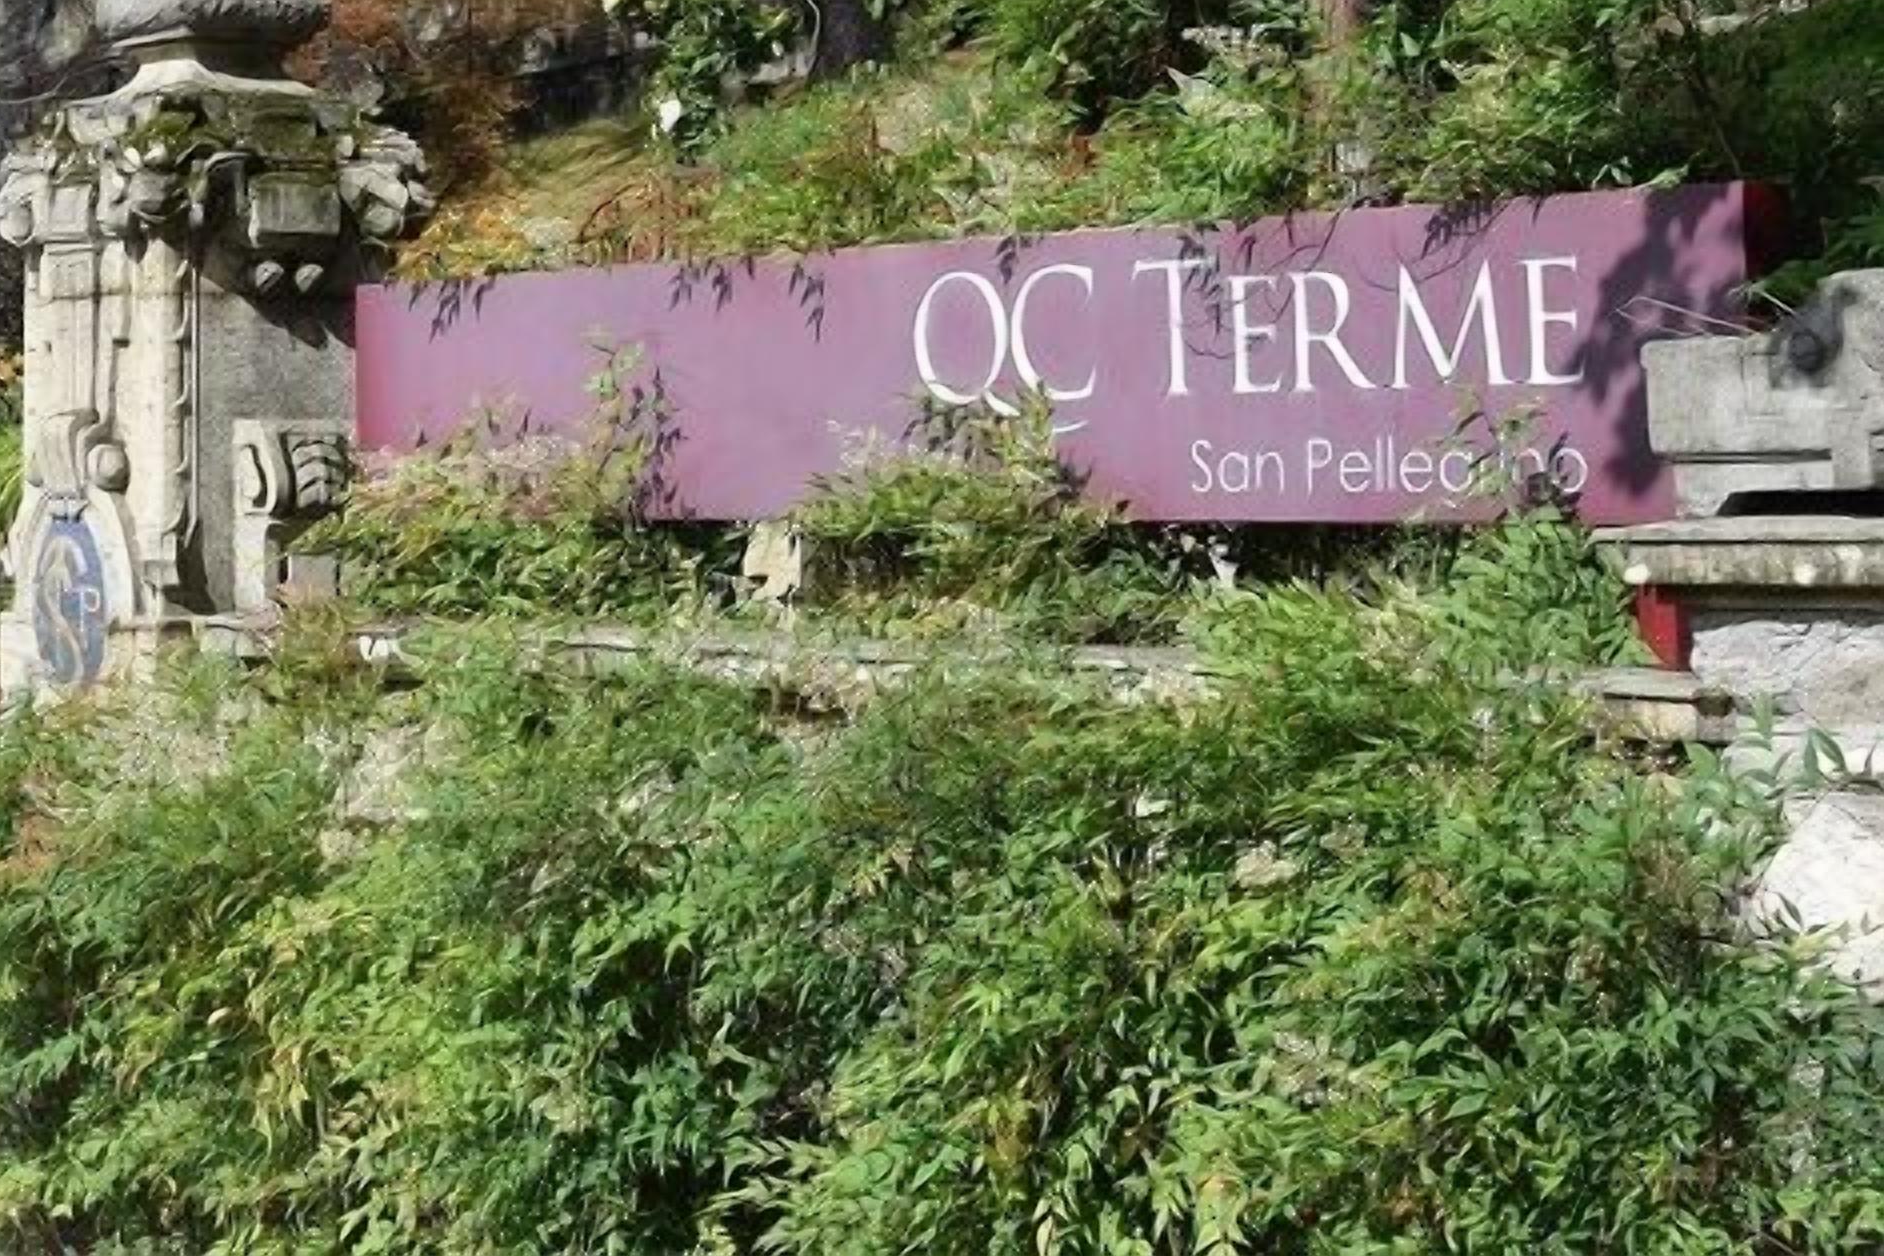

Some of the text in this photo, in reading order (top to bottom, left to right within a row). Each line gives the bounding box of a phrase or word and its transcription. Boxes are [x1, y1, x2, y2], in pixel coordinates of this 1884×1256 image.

[913, 254, 1585, 434] QC TERME
[1191, 439, 1286, 493] San
